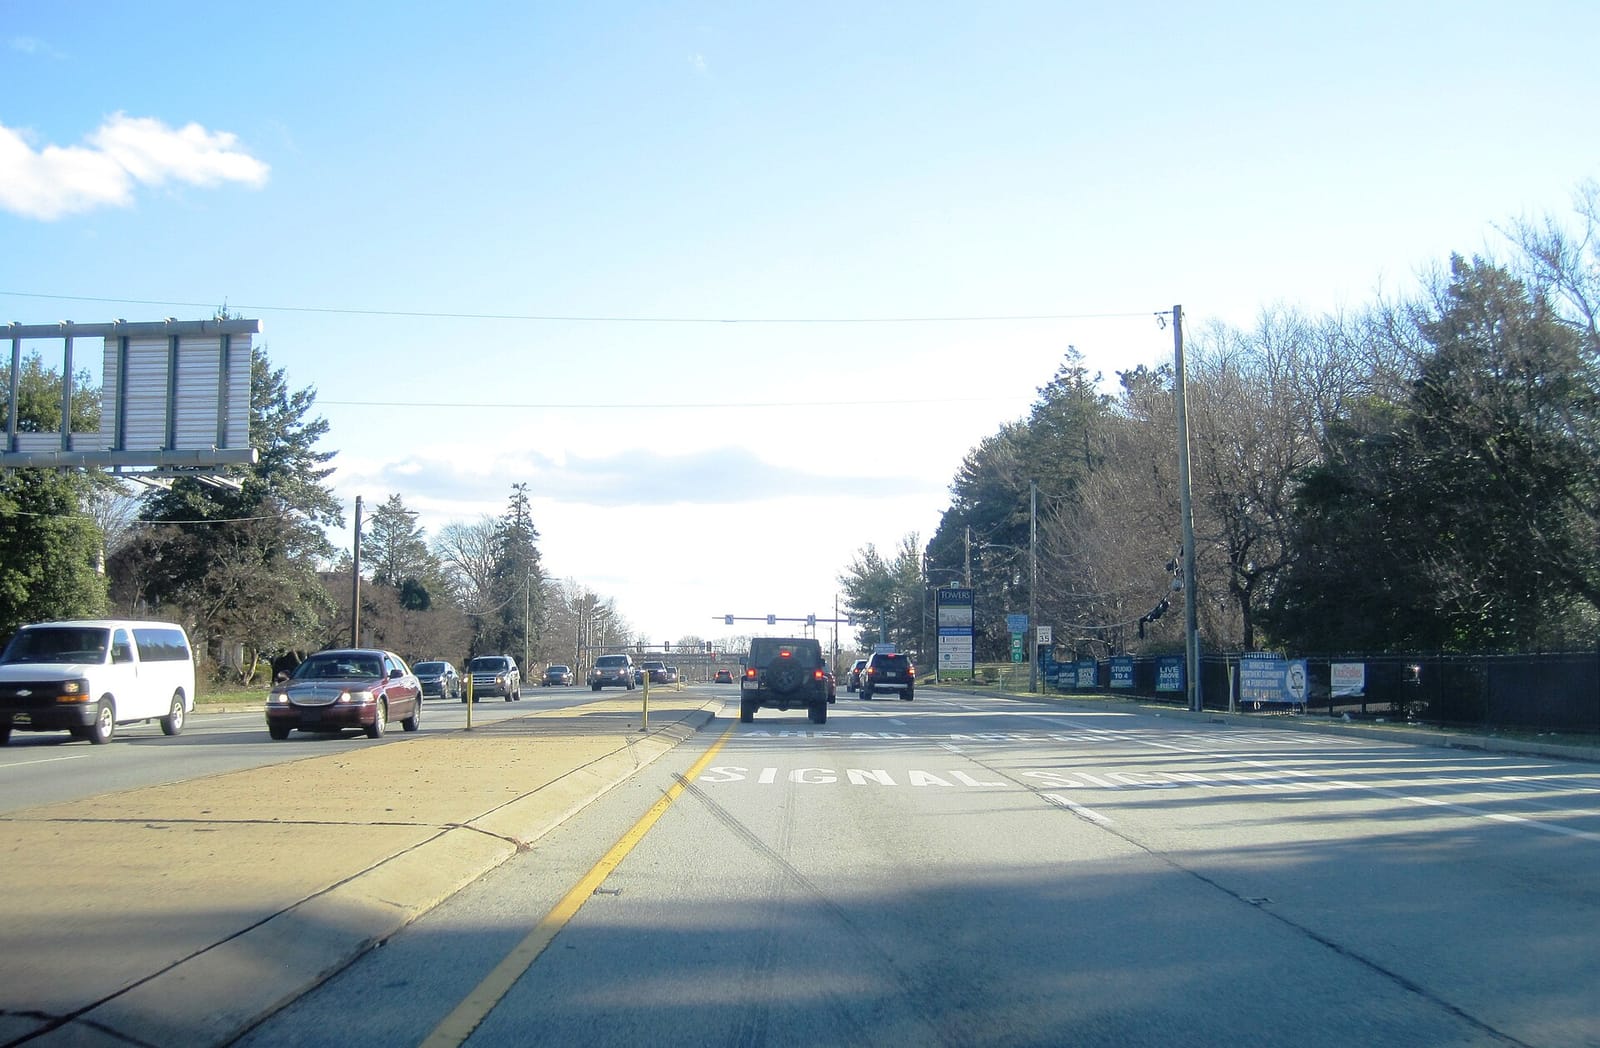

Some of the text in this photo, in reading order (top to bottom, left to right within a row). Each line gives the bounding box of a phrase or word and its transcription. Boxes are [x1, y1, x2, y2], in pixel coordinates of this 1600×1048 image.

[941, 591, 970, 599] TOWERS
[742, 731, 911, 739] AHEAD
[699, 766, 1008, 787] SIGNAL
